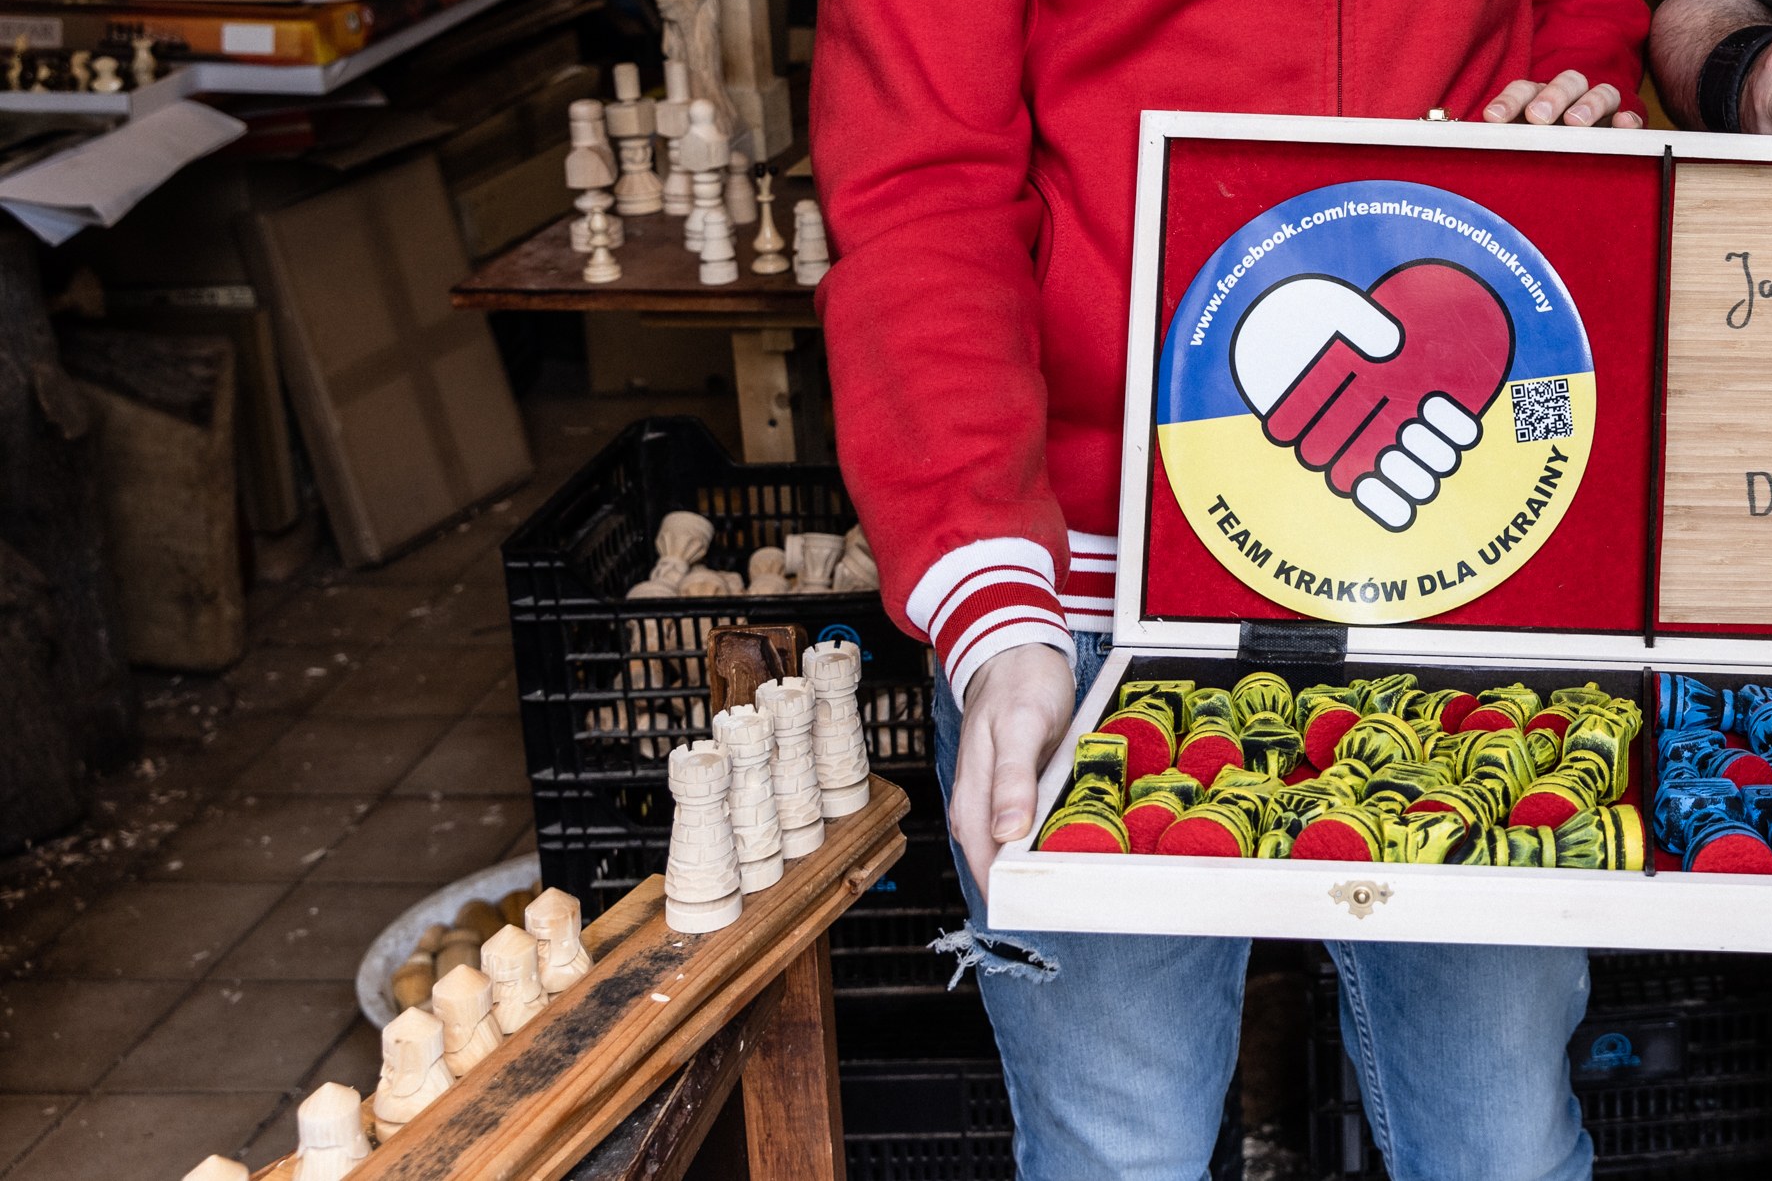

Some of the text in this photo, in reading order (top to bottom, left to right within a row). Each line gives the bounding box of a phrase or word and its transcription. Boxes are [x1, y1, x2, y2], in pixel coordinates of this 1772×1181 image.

[1188, 198, 1554, 348] www.facebook.com/teamkrakowdlaukrainy
[1206, 444, 1571, 604] TEAM KRAKÓW DLA UKRAINY
